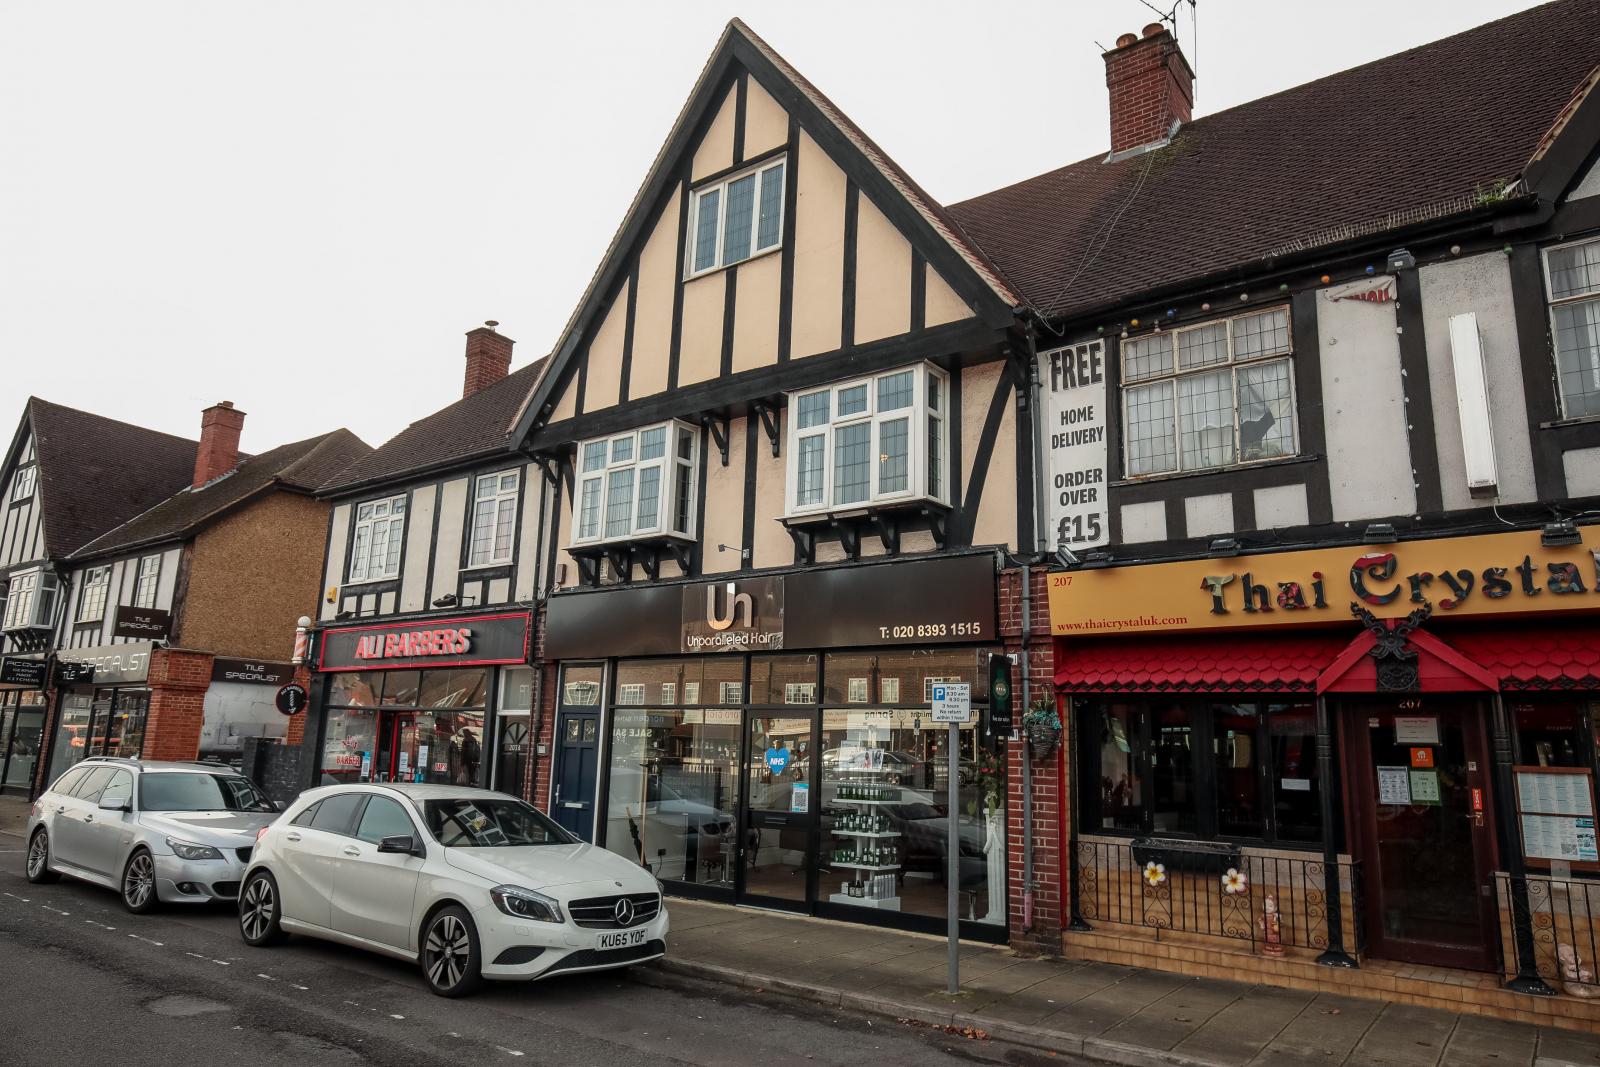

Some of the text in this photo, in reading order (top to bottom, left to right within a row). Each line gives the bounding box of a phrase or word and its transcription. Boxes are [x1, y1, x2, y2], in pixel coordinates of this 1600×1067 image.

[1050, 342, 1103, 392] FREE
[1061, 405, 1094, 426] HOME
[1051, 426, 1105, 450] DELIVERY
[1054, 467, 1103, 489] ORDER
[1060, 487, 1098, 507] OVER
[1057, 512, 1101, 544] £15
[1053, 576, 1073, 587] 207
[1199, 570, 1330, 615] Thai
[879, 622, 981, 639] T: 020 8393 1515
[1057, 615, 1188, 632] www.thaicrystaluk.com
[384, 628, 472, 658] BARBERS
[750, 631, 772, 644] Hair
[80, 652, 148, 674] SPECIALIST
[245, 663, 265, 672] TILE
[225, 671, 281, 682] SPECIALIST
[1399, 698, 1421, 709] 207
[769, 757, 785, 766] NHS
[601, 930, 645, 948] KU65 YOF
